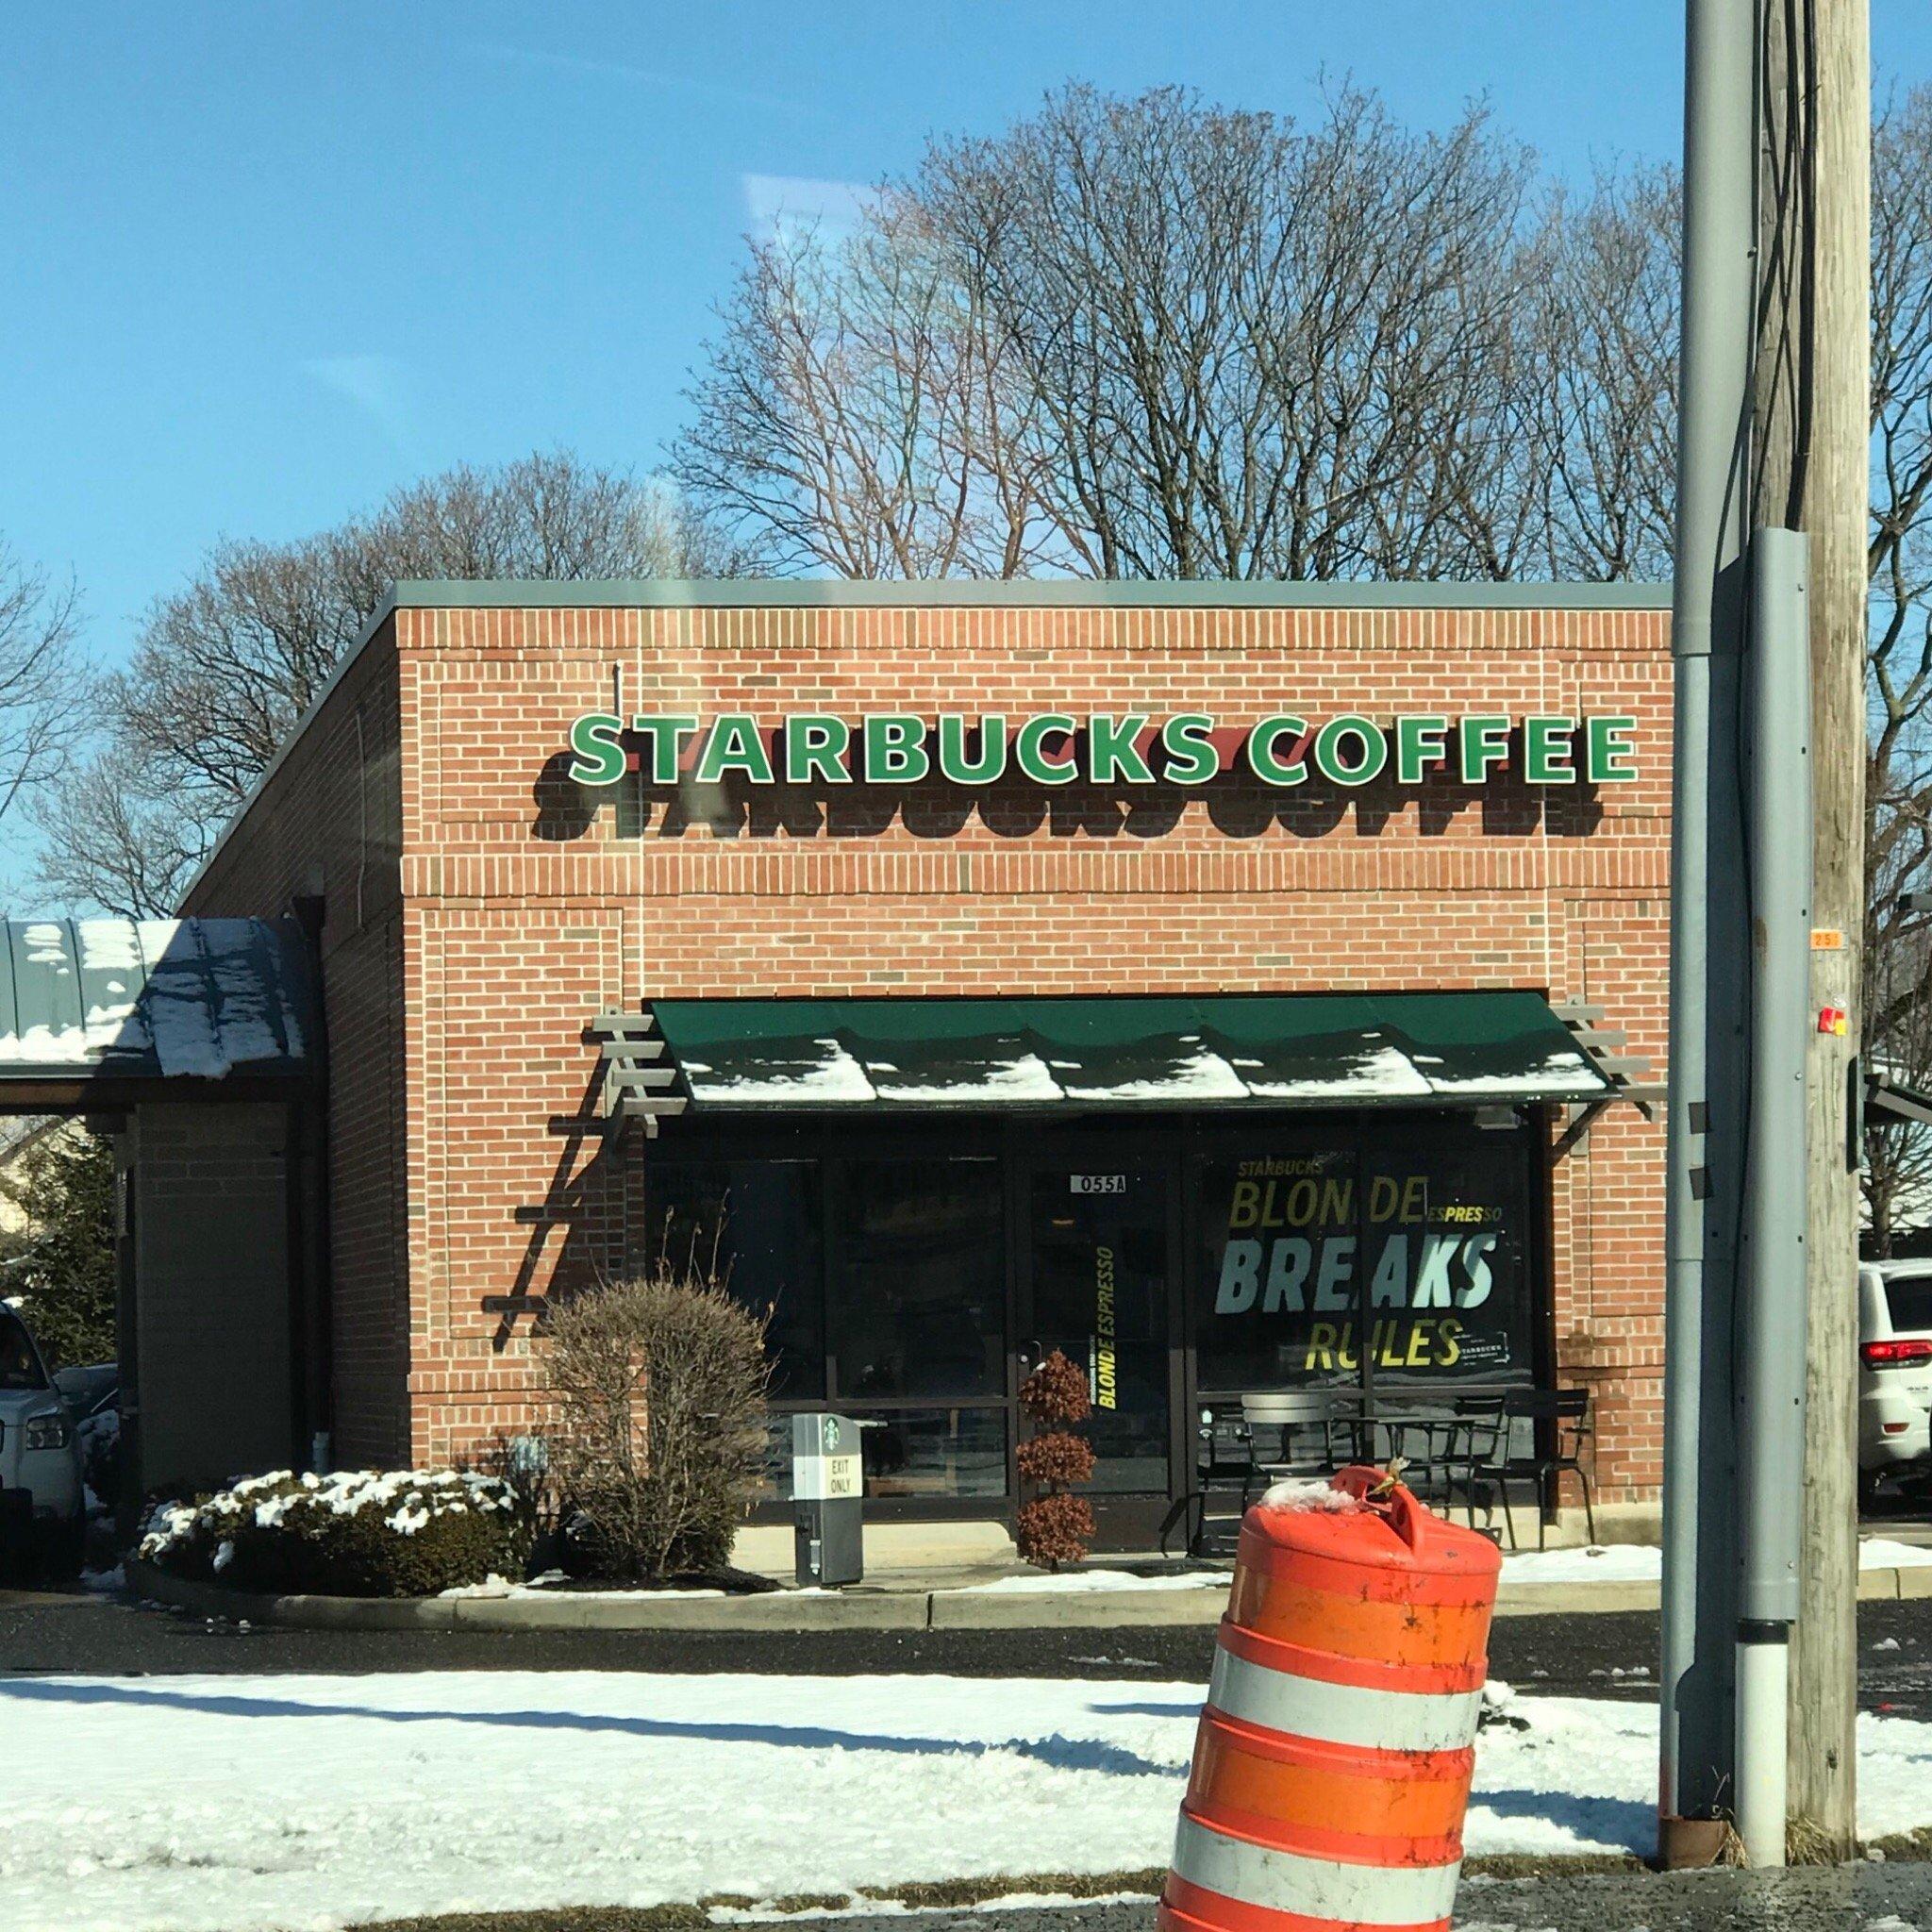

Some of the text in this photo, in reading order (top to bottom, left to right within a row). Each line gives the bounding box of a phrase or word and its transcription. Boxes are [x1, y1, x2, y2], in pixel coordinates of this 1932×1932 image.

[568, 712, 1640, 786] STARBUCKS COFFEE
[1237, 1158, 1324, 1177] STARBUCKS
[1080, 1175, 1125, 1193] 055A
[1427, 1206, 1503, 1224] ESPRESSO
[1214, 1232, 1498, 1315] BREAKS
[1097, 1245, 1117, 1410] BLONDE ESPRESSO
[1305, 1318, 1464, 1371] RULES
[832, 1459, 849, 1474] EXIT
[831, 1479, 850, 1493] ONLY
